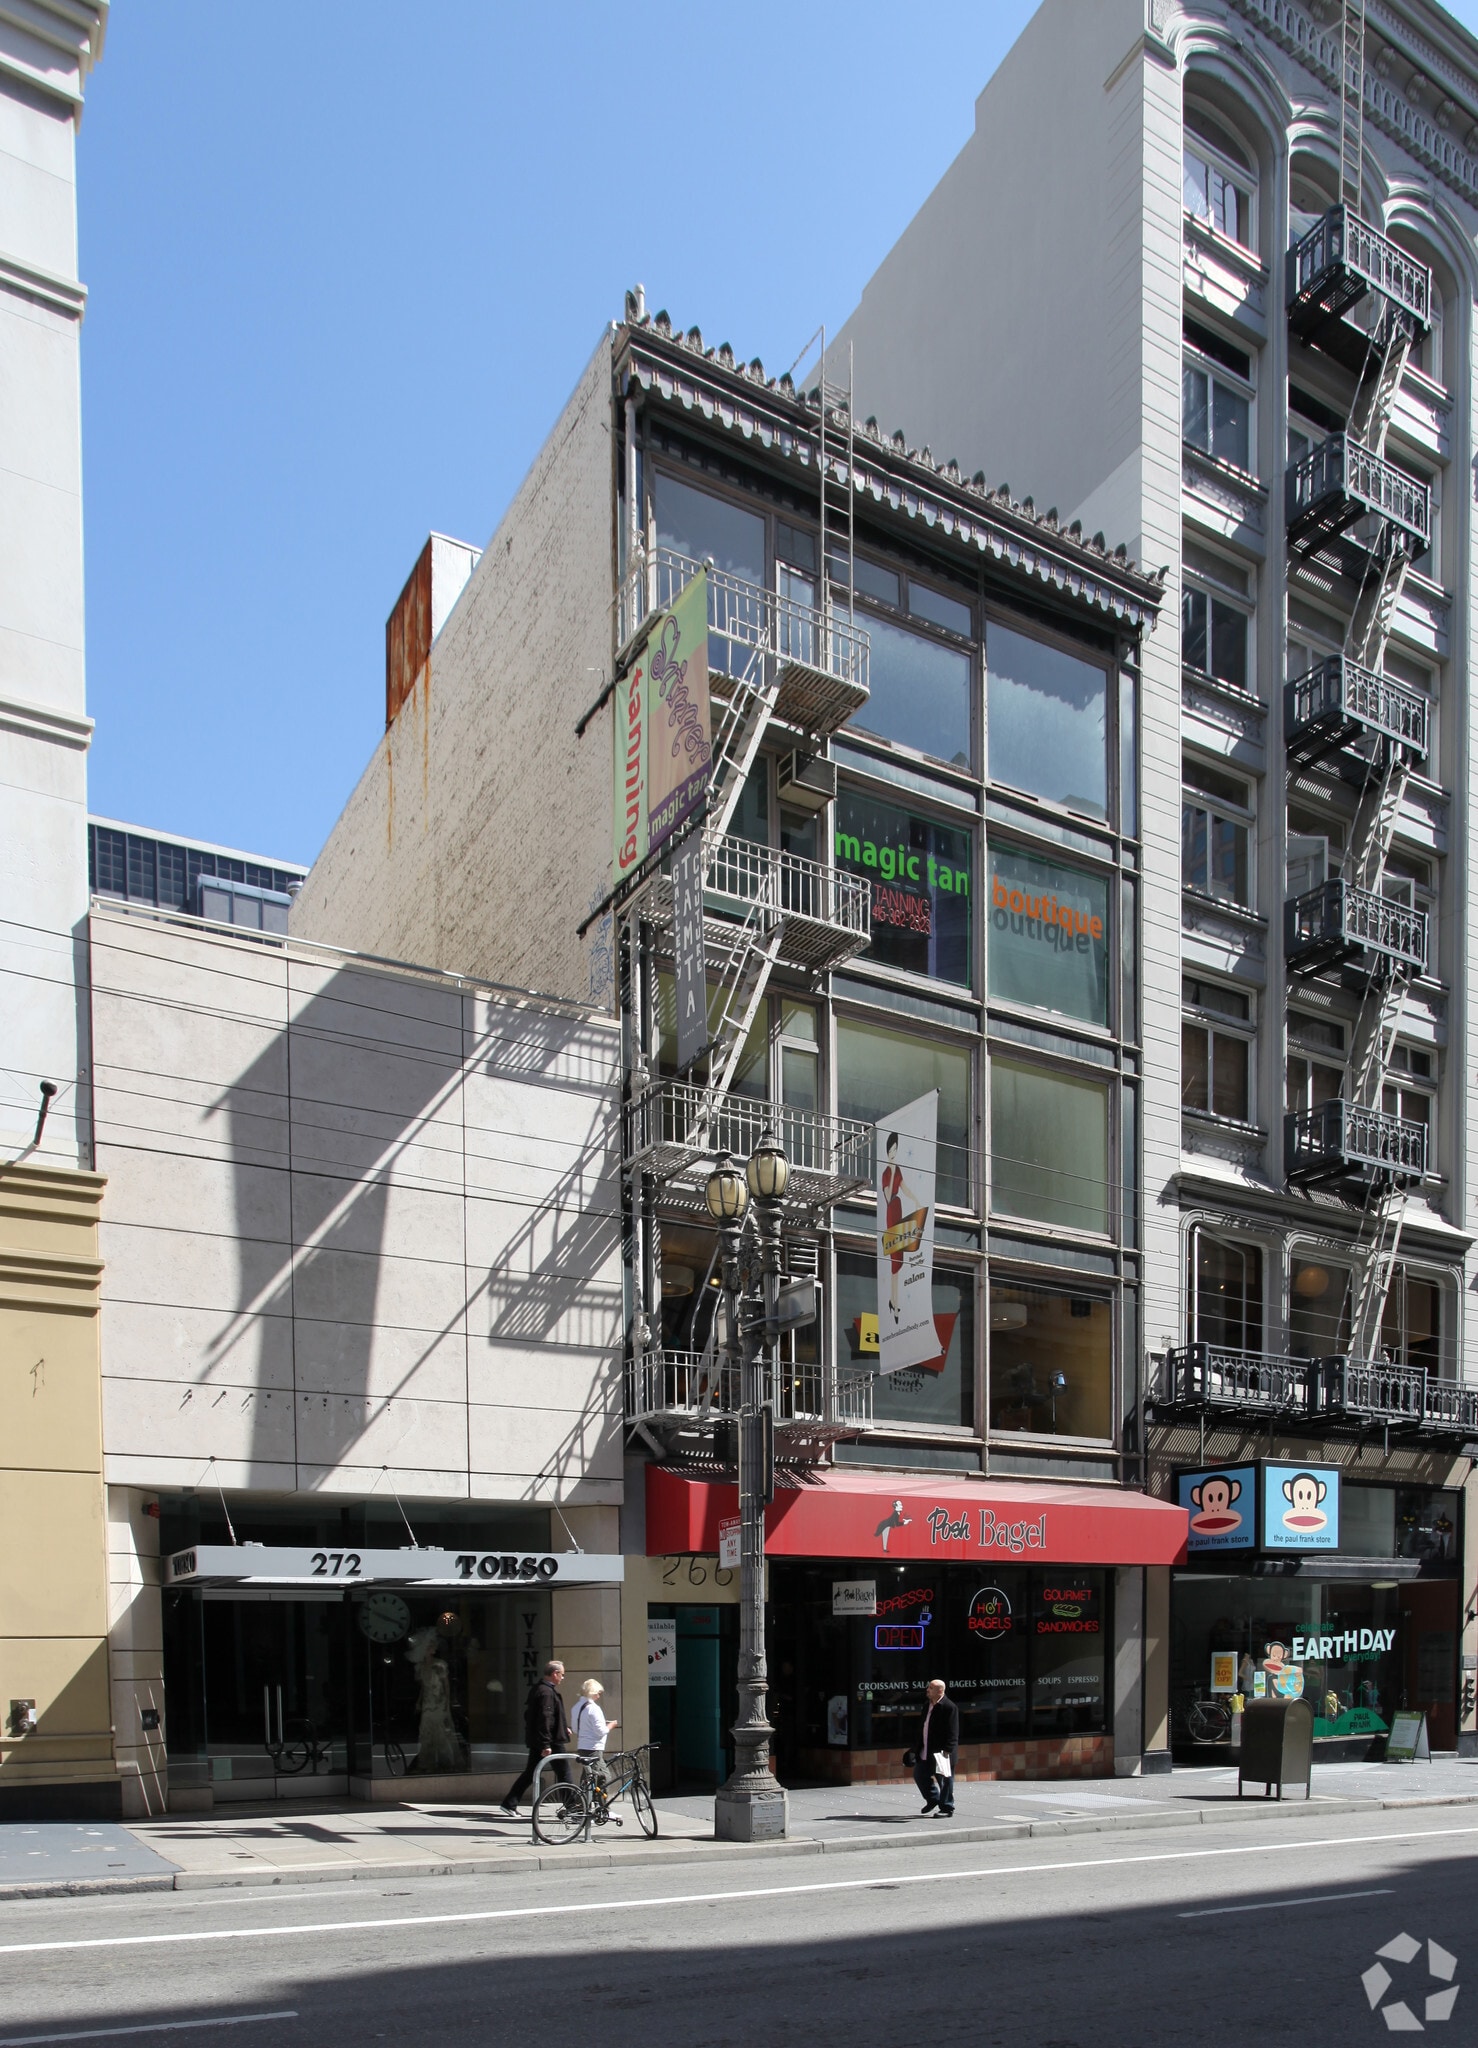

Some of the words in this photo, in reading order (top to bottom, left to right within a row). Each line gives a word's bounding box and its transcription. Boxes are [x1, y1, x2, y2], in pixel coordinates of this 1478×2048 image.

[619, 666, 644, 869] tanning
[652, 790, 686, 837] magic
[688, 772, 708, 802] tan
[835, 831, 920, 880] magic
[927, 856, 969, 896] tan
[873, 883, 931, 919] TANNING
[993, 873, 1103, 940] boutique
[672, 863, 682, 981] GALLERY
[692, 852, 702, 974] COUTURE
[681, 851, 696, 1018] TAMTA
[904, 1271, 925, 1287] salon
[927, 1506, 971, 1545] Posh
[978, 1509, 1047, 1553] Bagel
[1273, 1534, 1284, 1543] the
[1285, 1535, 1299, 1545] paul
[1299, 1534, 1315, 1544] frank
[1316, 1536, 1331, 1544] store
[727, 1539, 737, 1548] ANY
[1195, 1536, 1211, 1547] paul
[1212, 1535, 1229, 1545] frank
[1230, 1535, 1249, 1544] store
[726, 1548, 738, 1558] TIME
[310, 1552, 362, 1577] 272
[455, 1555, 559, 1580] TORSO
[663, 1556, 733, 1586] 266
[855, 1587, 875, 1602] Bagel
[868, 1588, 934, 1617] SPRESSO
[1043, 1588, 1092, 1601] GOURMET
[976, 1601, 1003, 1615] HOT
[648, 1622, 675, 1630] ailable
[968, 1616, 1012, 1630] BAGELS
[1037, 1620, 1099, 1633] SANDWICHES
[877, 1627, 922, 1647] OPEN
[522, 1613, 539, 1688] VINT
[858, 1681, 909, 1691] CROISSANTS
[912, 1681, 930, 1689] SALA
[949, 1679, 977, 1688] BAGELS
[980, 1678, 1026, 1687] SANDWICHES
[1038, 1676, 1062, 1685] SOUPS
[1067, 1675, 1099, 1684] ESPRESSO
[1349, 1720, 1371, 1730] FRANK
[1354, 1712, 1370, 1720] PAUL
